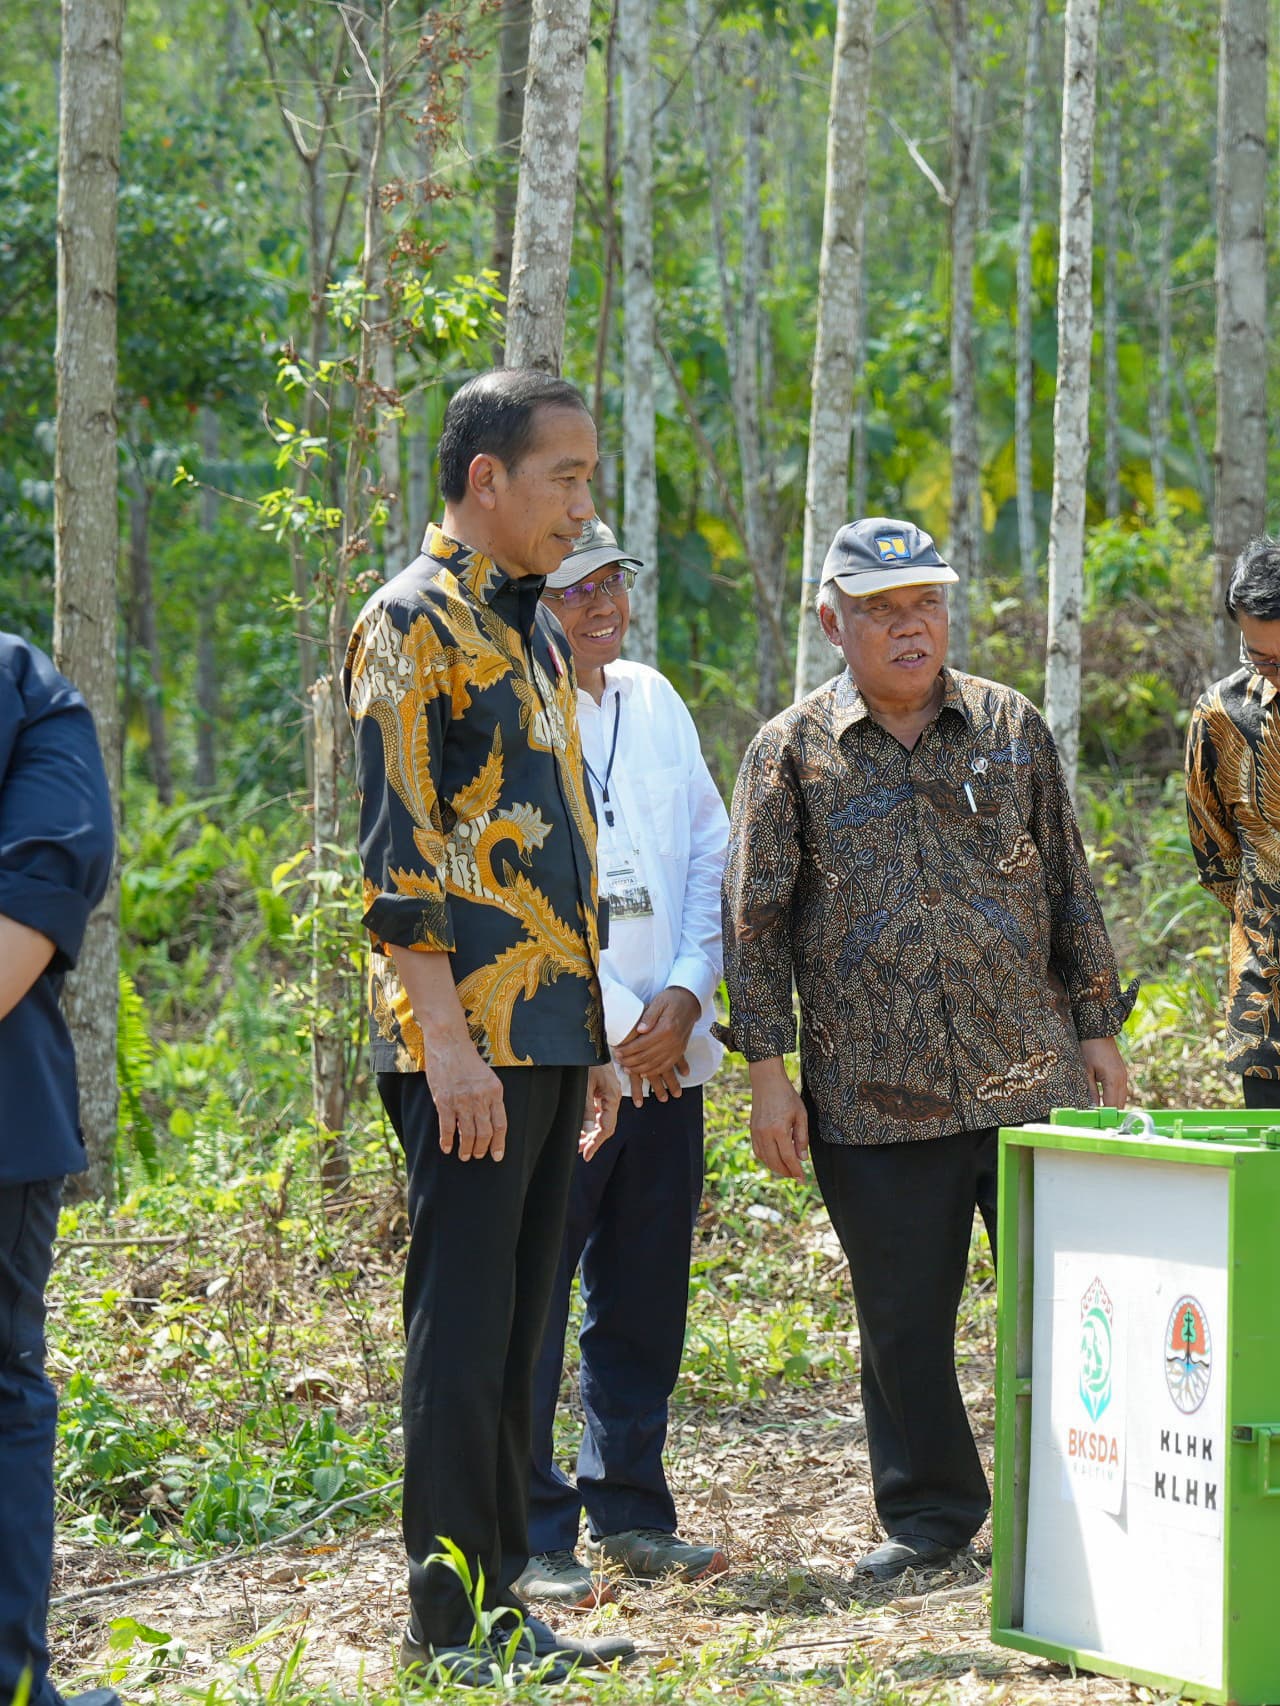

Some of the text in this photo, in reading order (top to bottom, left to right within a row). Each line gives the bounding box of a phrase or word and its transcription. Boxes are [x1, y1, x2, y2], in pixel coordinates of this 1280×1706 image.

[1068, 1428, 1118, 1466] BKSDA
[1160, 1429, 1213, 1461] KLHK
[1154, 1471, 1217, 1510] KLHK
